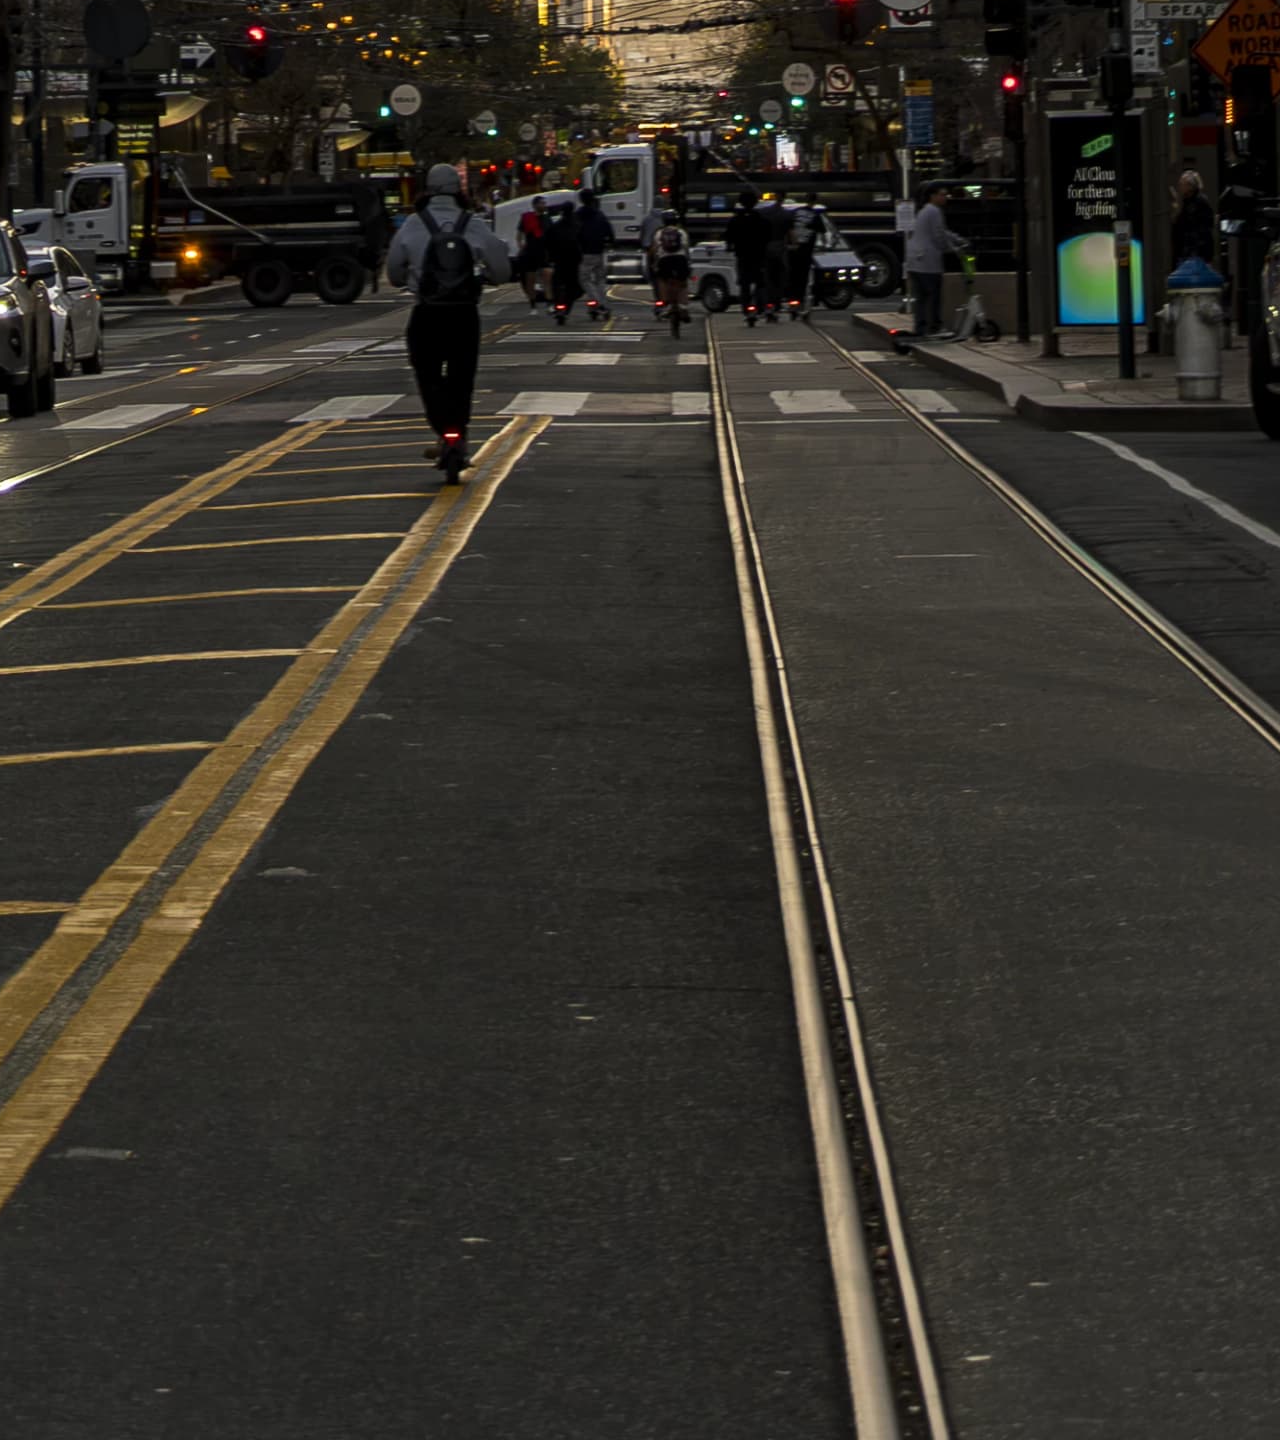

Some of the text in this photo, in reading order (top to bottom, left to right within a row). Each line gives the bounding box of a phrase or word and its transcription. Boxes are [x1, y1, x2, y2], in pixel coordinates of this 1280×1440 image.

[1161, 4, 1215, 16] SPEAR
[1088, 166, 1116, 182] Clou
[1066, 184, 1083, 200] for
